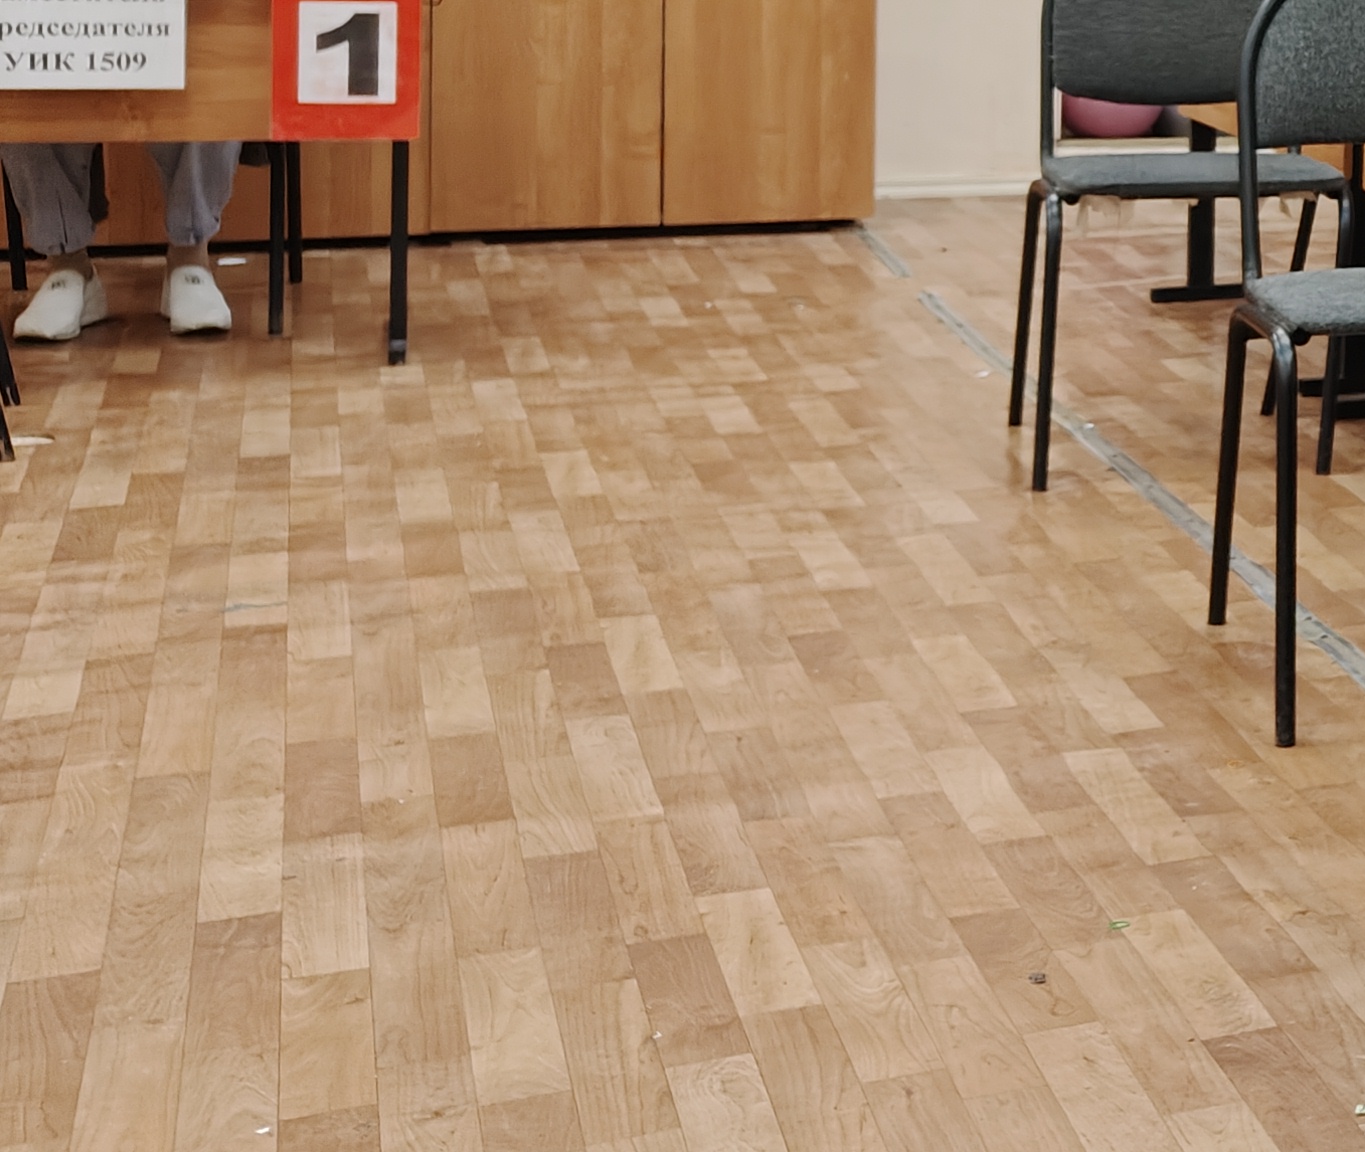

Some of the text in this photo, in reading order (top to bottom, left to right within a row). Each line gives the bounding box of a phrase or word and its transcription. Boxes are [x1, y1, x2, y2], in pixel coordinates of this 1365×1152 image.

[4, 51, 147, 72] УИК 1509
[315, 12, 380, 97] 1
